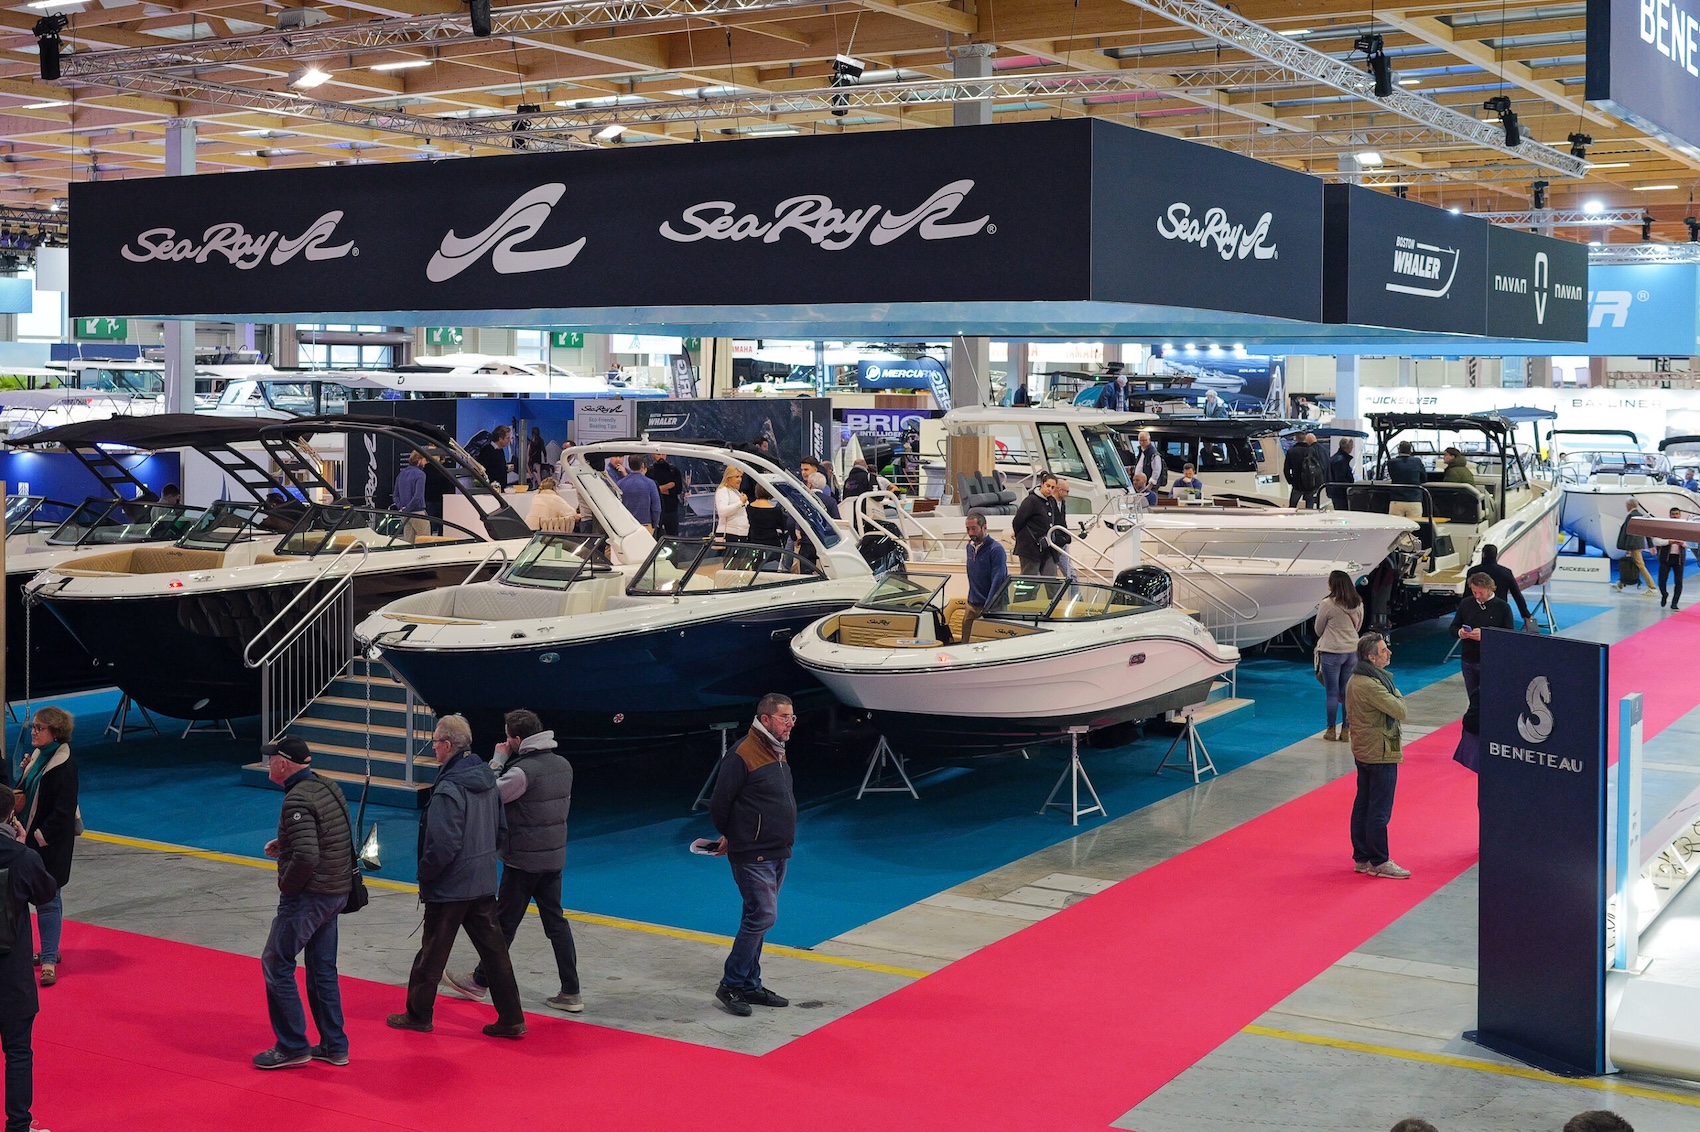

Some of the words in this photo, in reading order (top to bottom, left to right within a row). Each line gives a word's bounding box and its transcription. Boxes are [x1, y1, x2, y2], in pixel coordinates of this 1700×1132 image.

[1640, 0, 1700, 77] BENE
[659, 201, 772, 242] Sea
[763, 194, 882, 251] Ray
[1156, 202, 1204, 243] Sea
[1200, 207, 1243, 261] Ray
[120, 227, 202, 262] Sea
[195, 222, 279, 270] Ray
[1396, 236, 1416, 249] BOSTON
[1393, 250, 1441, 279] WHALER
[1572, 399, 1662, 408] BALINER
[648, 417, 678, 426] WHALER
[1489, 742, 1583, 773] BENETEAU
